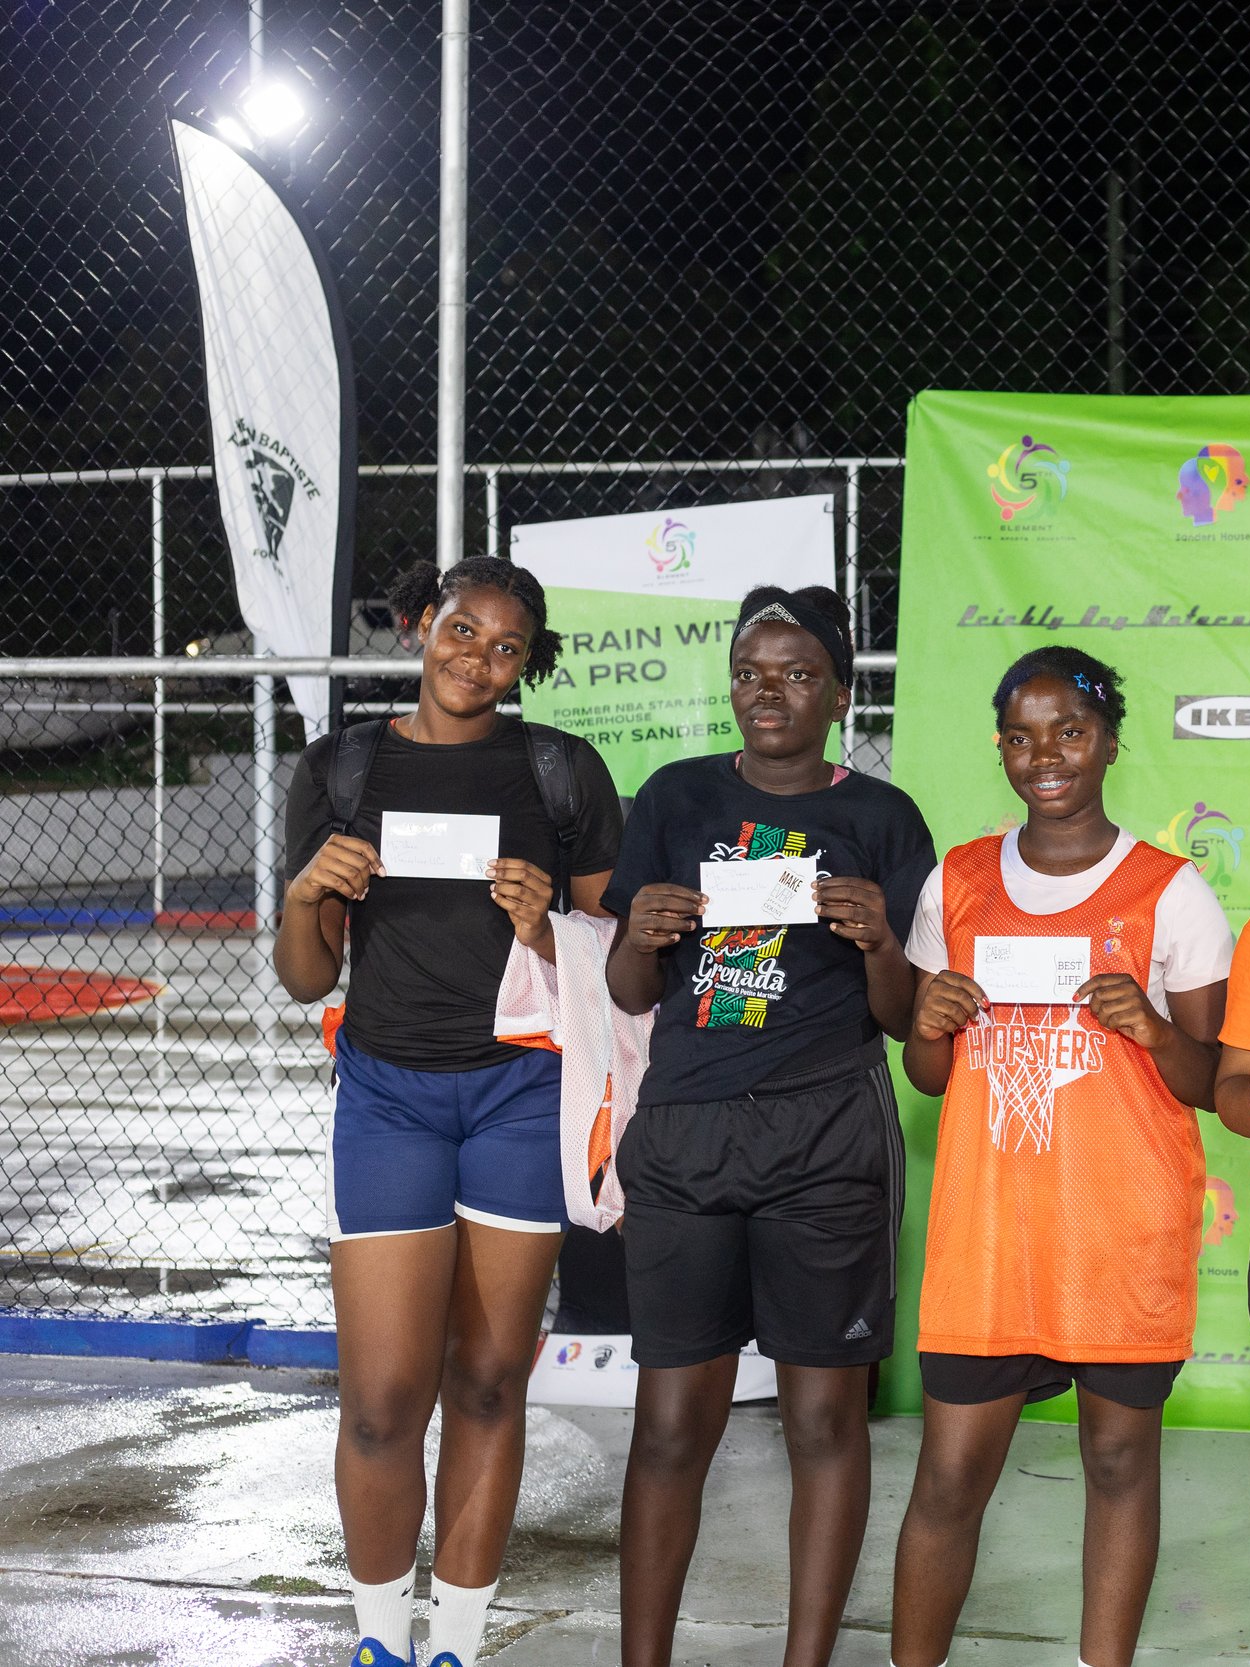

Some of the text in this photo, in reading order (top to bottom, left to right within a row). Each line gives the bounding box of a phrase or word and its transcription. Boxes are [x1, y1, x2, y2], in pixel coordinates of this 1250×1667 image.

[552, 659, 668, 690] A PRO
[553, 705, 611, 718] FORMER
[616, 702, 645, 714] NBA
[649, 699, 684, 711] STAR
[688, 696, 718, 707] AND
[554, 712, 652, 729] POWERHOUSE
[631, 721, 732, 743] SANDERS
[1190, 838, 1225, 858] 5TH
[778, 870, 803, 893] MAKE
[691, 951, 787, 996] Grenada
[1058, 961, 1083, 971] BEST
[1057, 975, 1082, 986] LIFE
[1207, 1266, 1240, 1277] House
[845, 1329, 873, 1340] adidas
